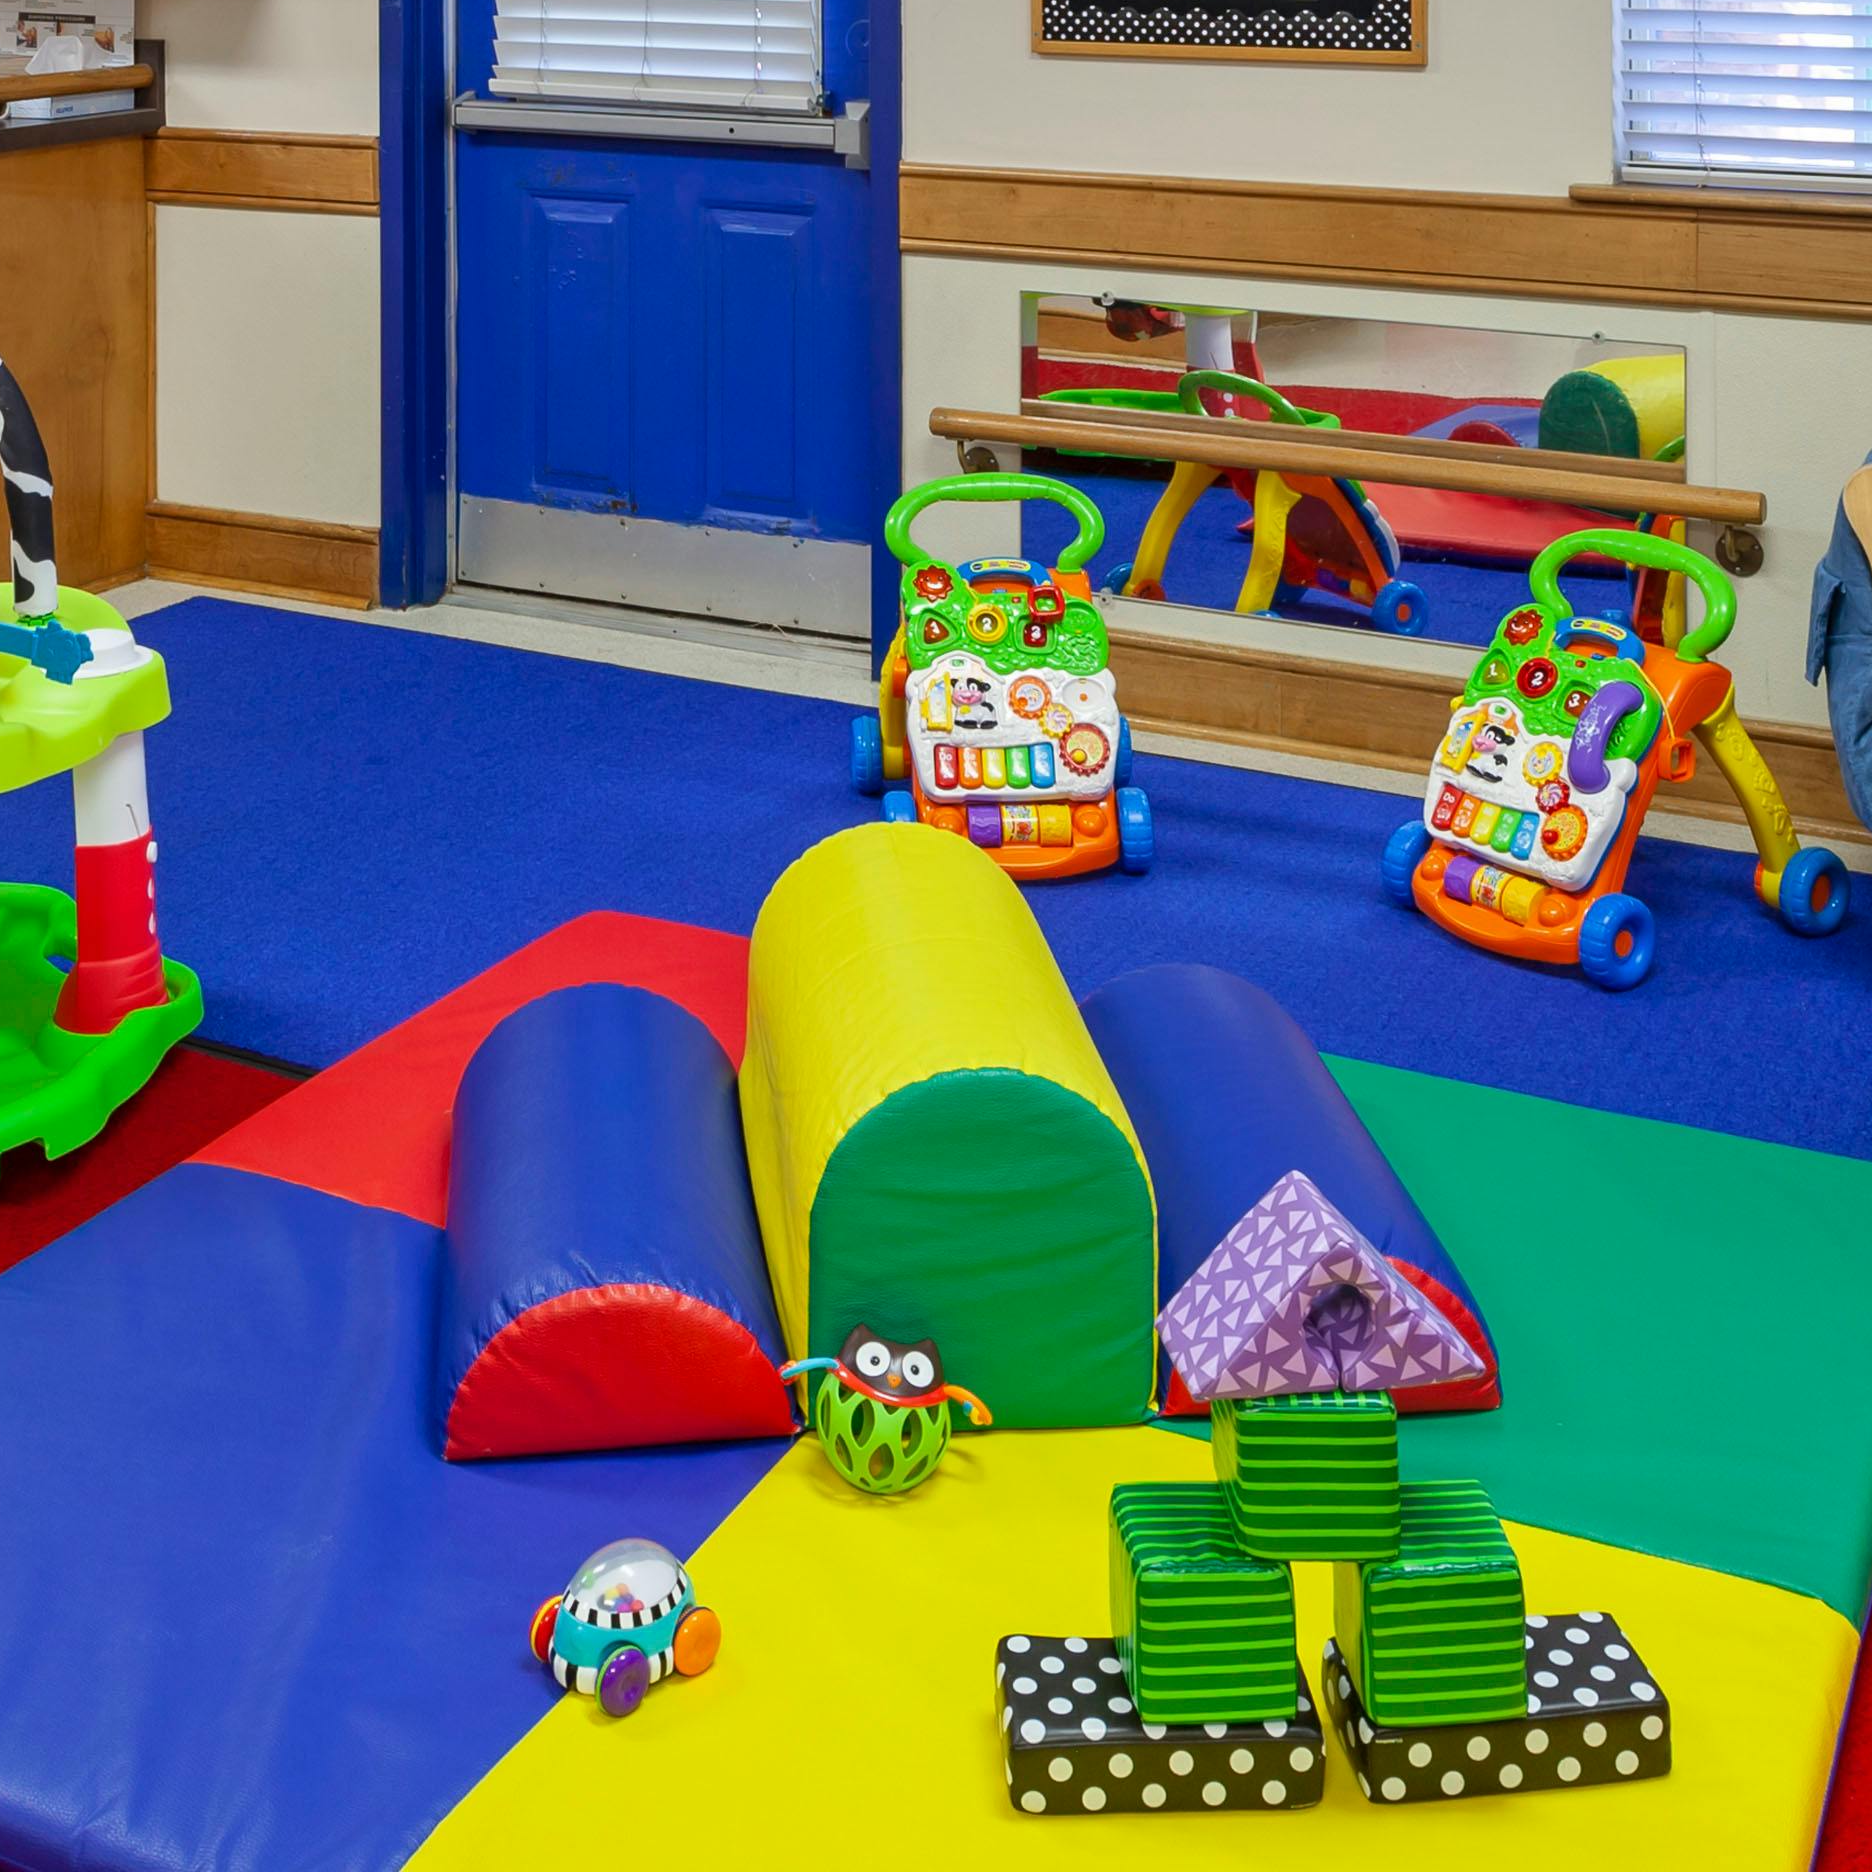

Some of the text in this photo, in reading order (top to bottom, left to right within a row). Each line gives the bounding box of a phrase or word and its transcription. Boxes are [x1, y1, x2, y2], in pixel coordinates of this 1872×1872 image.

[930, 621, 940, 634] 1
[982, 617, 992, 633] 2
[1031, 625, 1042, 640] 3
[1489, 663, 1498, 677] 1
[1531, 671, 1544, 686] 2
[1568, 693, 1581, 708] 3
